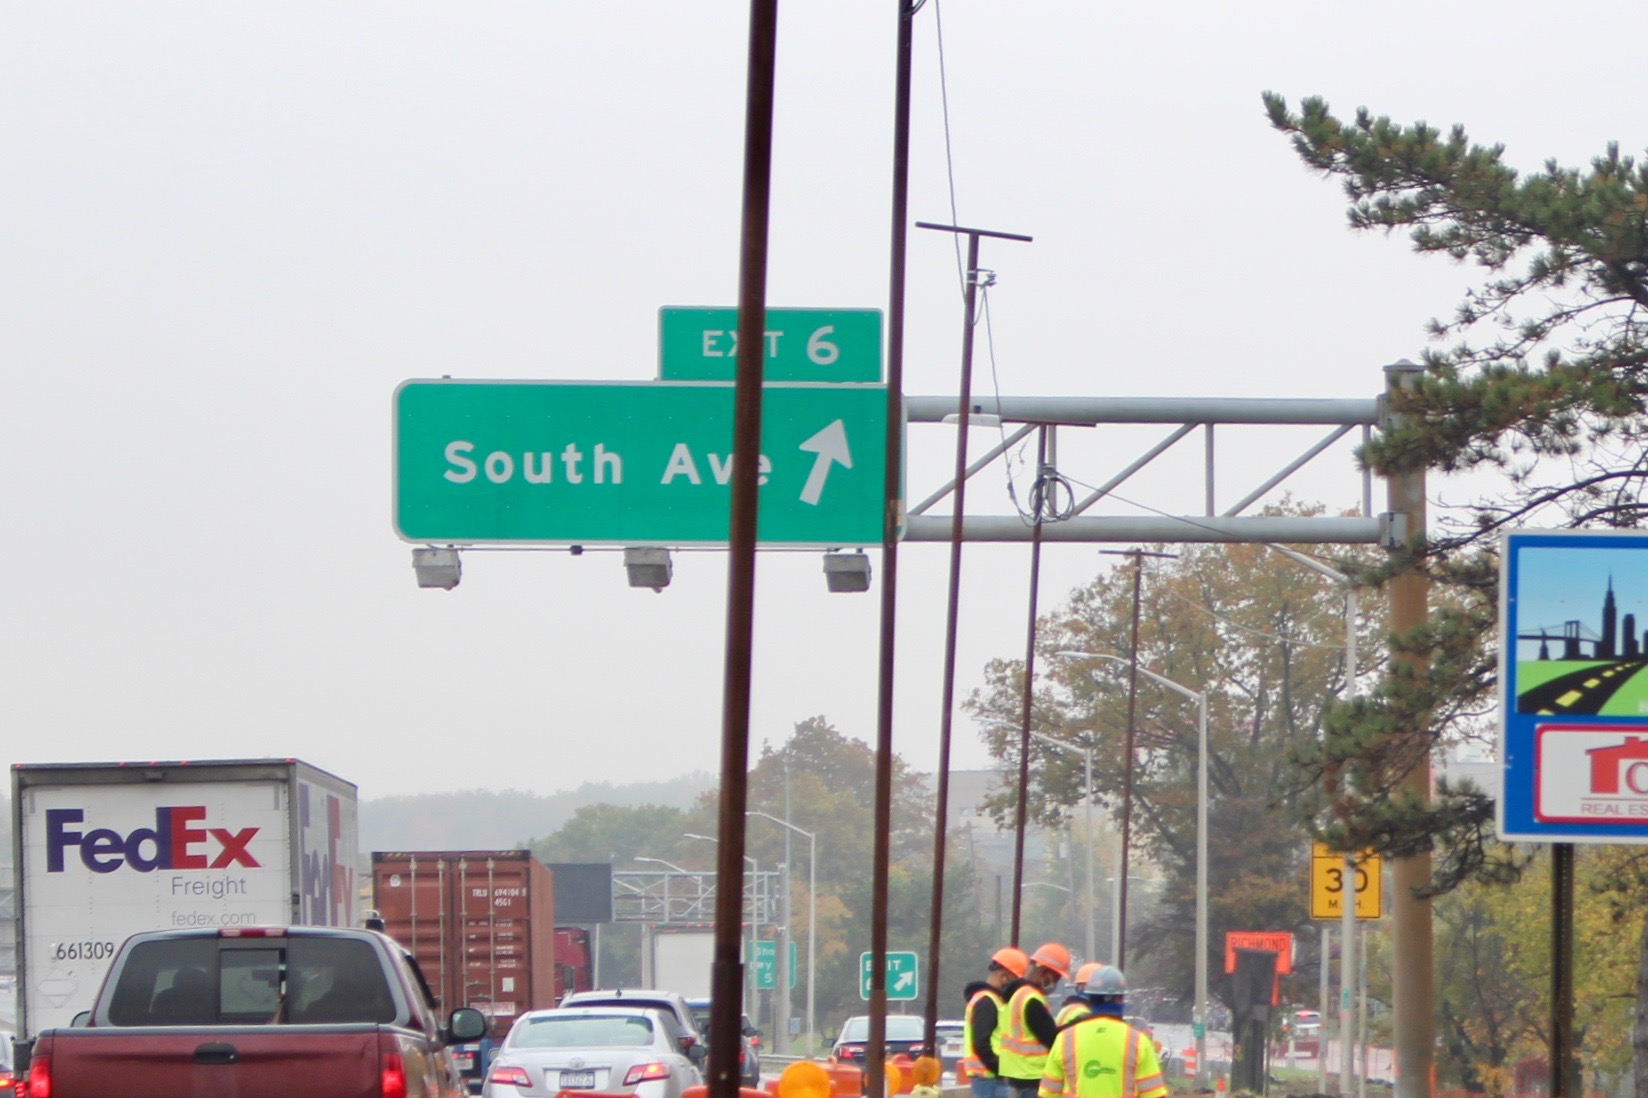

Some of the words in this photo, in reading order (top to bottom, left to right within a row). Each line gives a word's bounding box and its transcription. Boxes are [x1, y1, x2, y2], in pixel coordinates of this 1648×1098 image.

[807, 325, 839, 365] 6
[443, 440, 622, 484] South
[1581, 803, 1622, 816] REAL
[46, 806, 262, 873] FedEx
[172, 876, 247, 899] Freight
[1325, 868, 1368, 893] 30
[472, 888, 488, 897] TRLU
[494, 888, 519, 897] 694104
[171, 911, 256, 926] fedex.com
[56, 942, 114, 960] 661309
[865, 960, 901, 971] EIT
